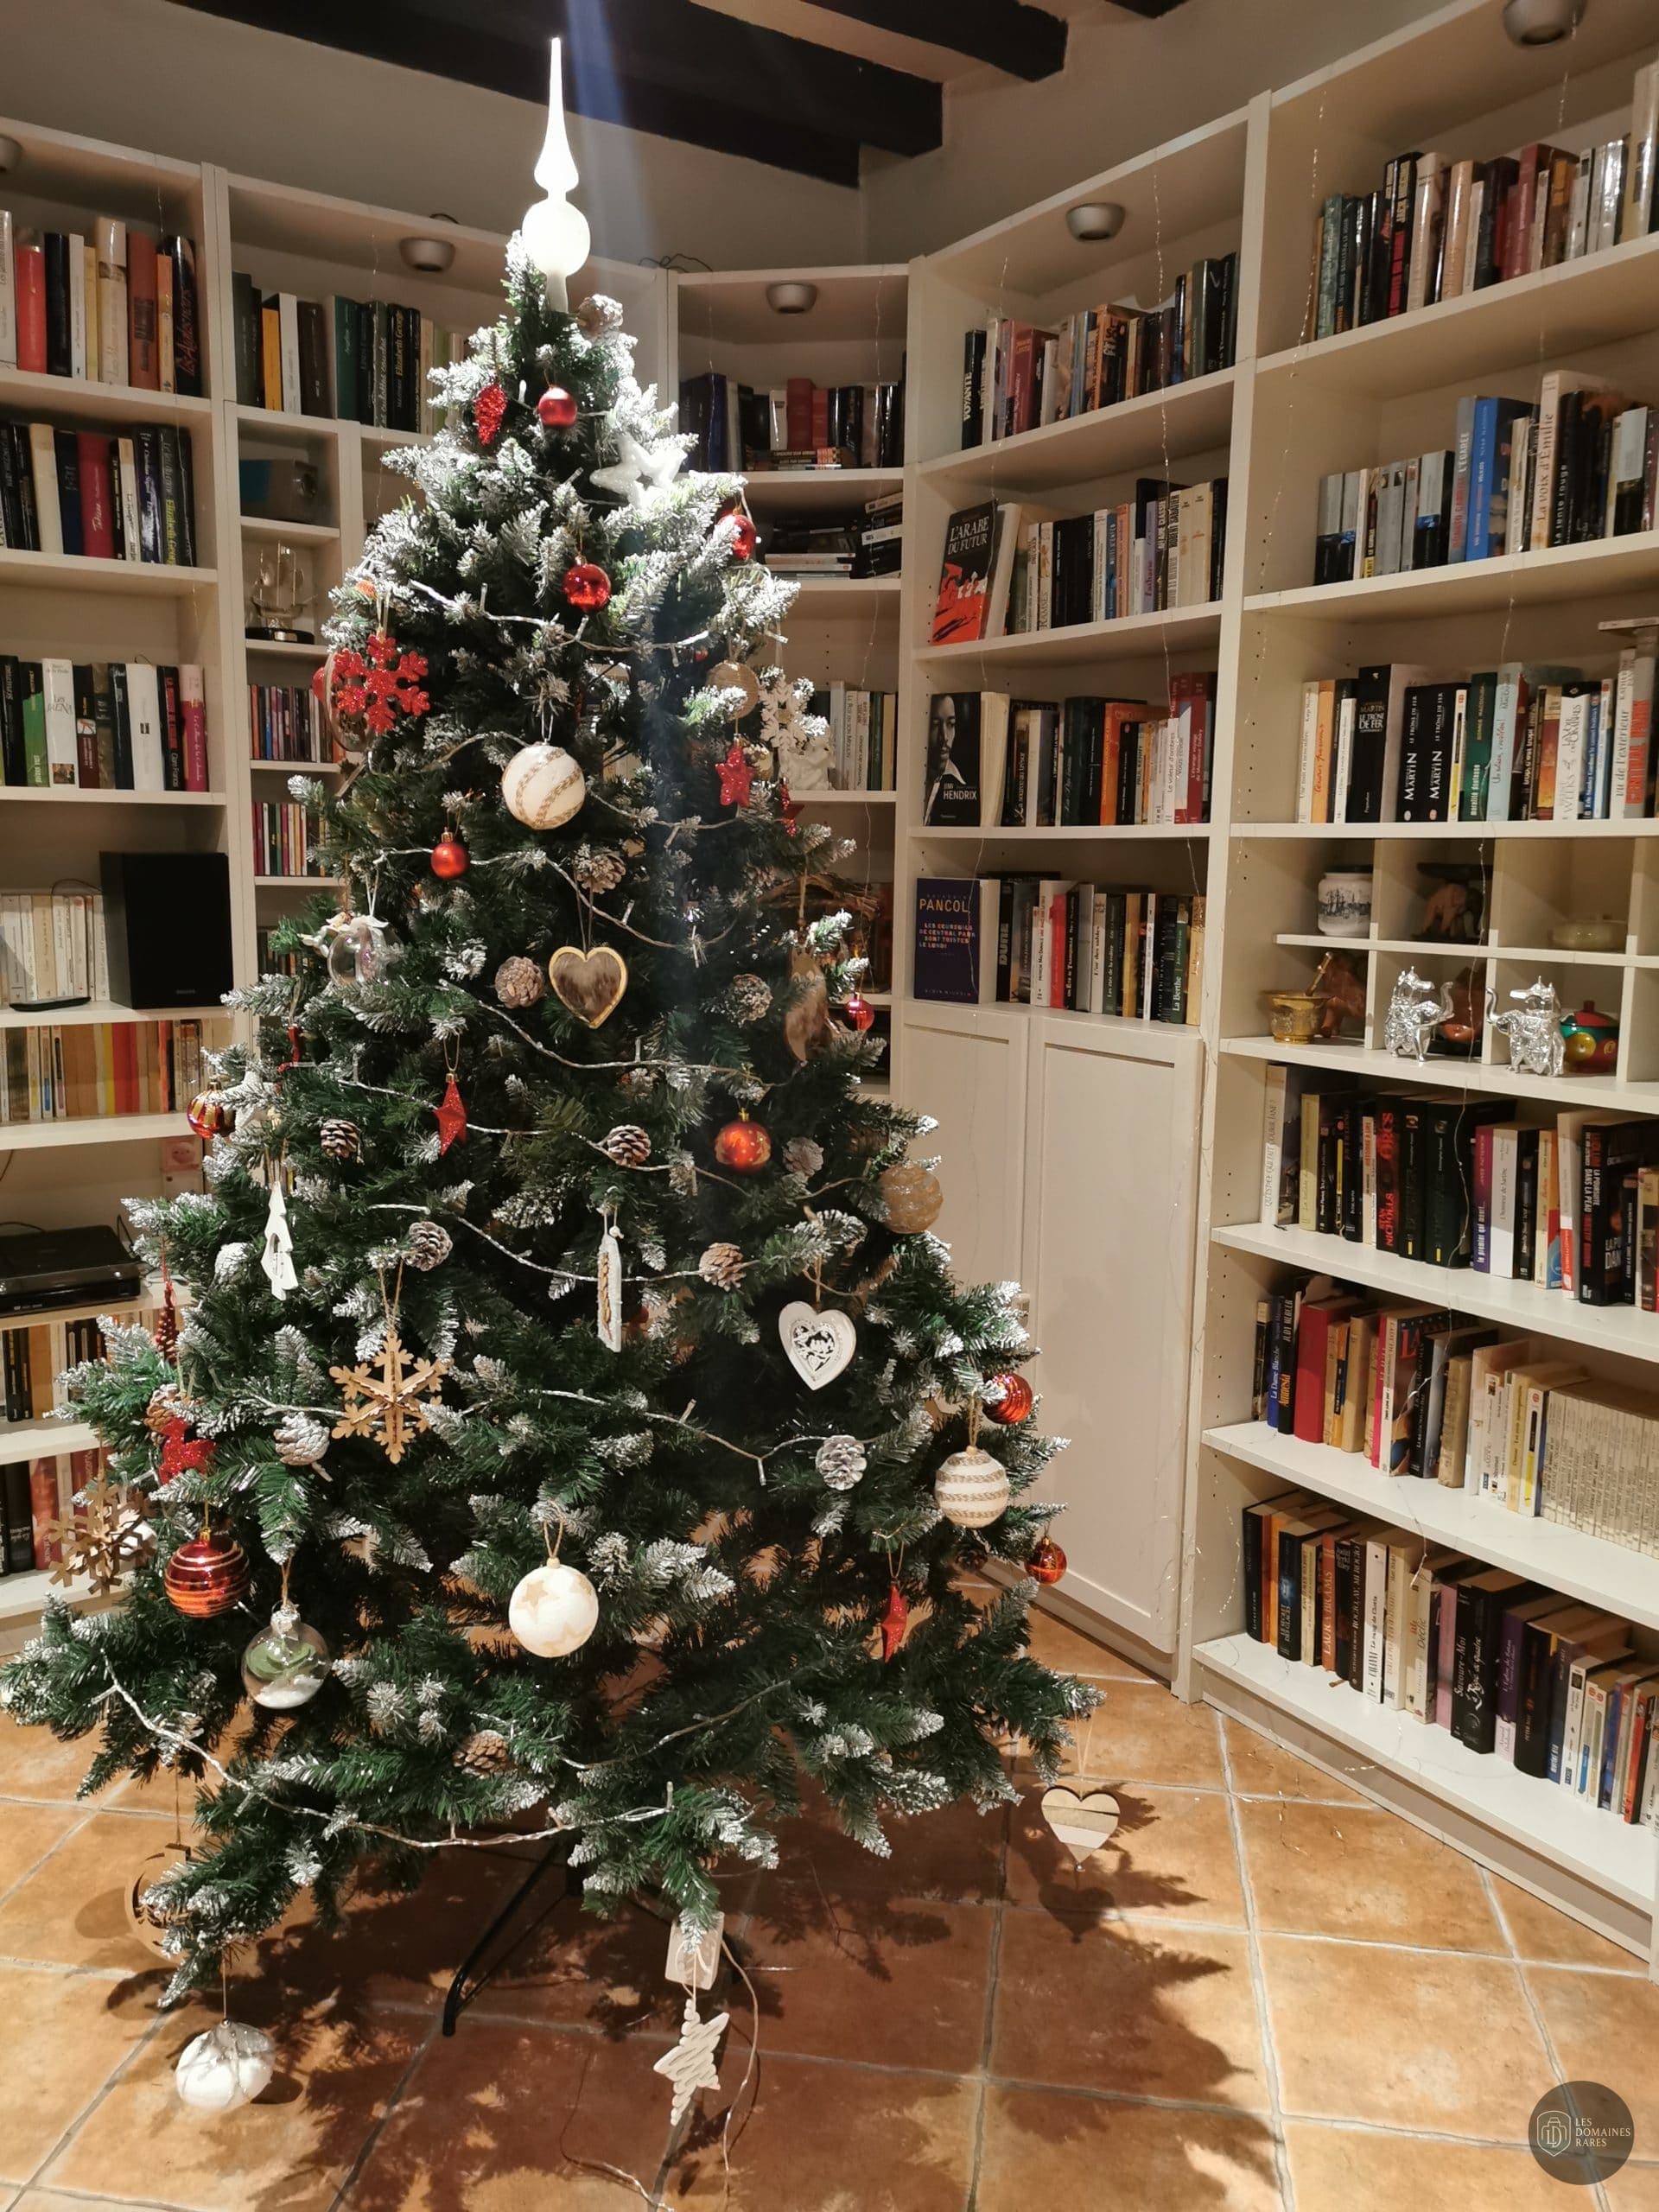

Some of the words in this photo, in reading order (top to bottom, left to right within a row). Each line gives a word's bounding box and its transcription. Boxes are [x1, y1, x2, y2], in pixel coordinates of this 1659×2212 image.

[963, 372, 972, 421] VOYANTE
[166, 499, 175, 538] Elizabeth
[950, 516, 989, 542] L'ARABE
[948, 542, 958, 555] DU
[959, 532, 988, 554] FUTUR
[1403, 753, 1418, 800] MARTIN
[1428, 750, 1443, 799] MARTIN
[1615, 768, 1624, 780] de
[943, 791, 977, 800] HENDRIX
[919, 899, 970, 912] PANCOL
[1173, 976, 1182, 1001] Berthe
[1173, 1002, 1180, 1011] La
[1584, 1168, 1592, 1184] DANS
[1584, 1185, 1592, 1194] LA
